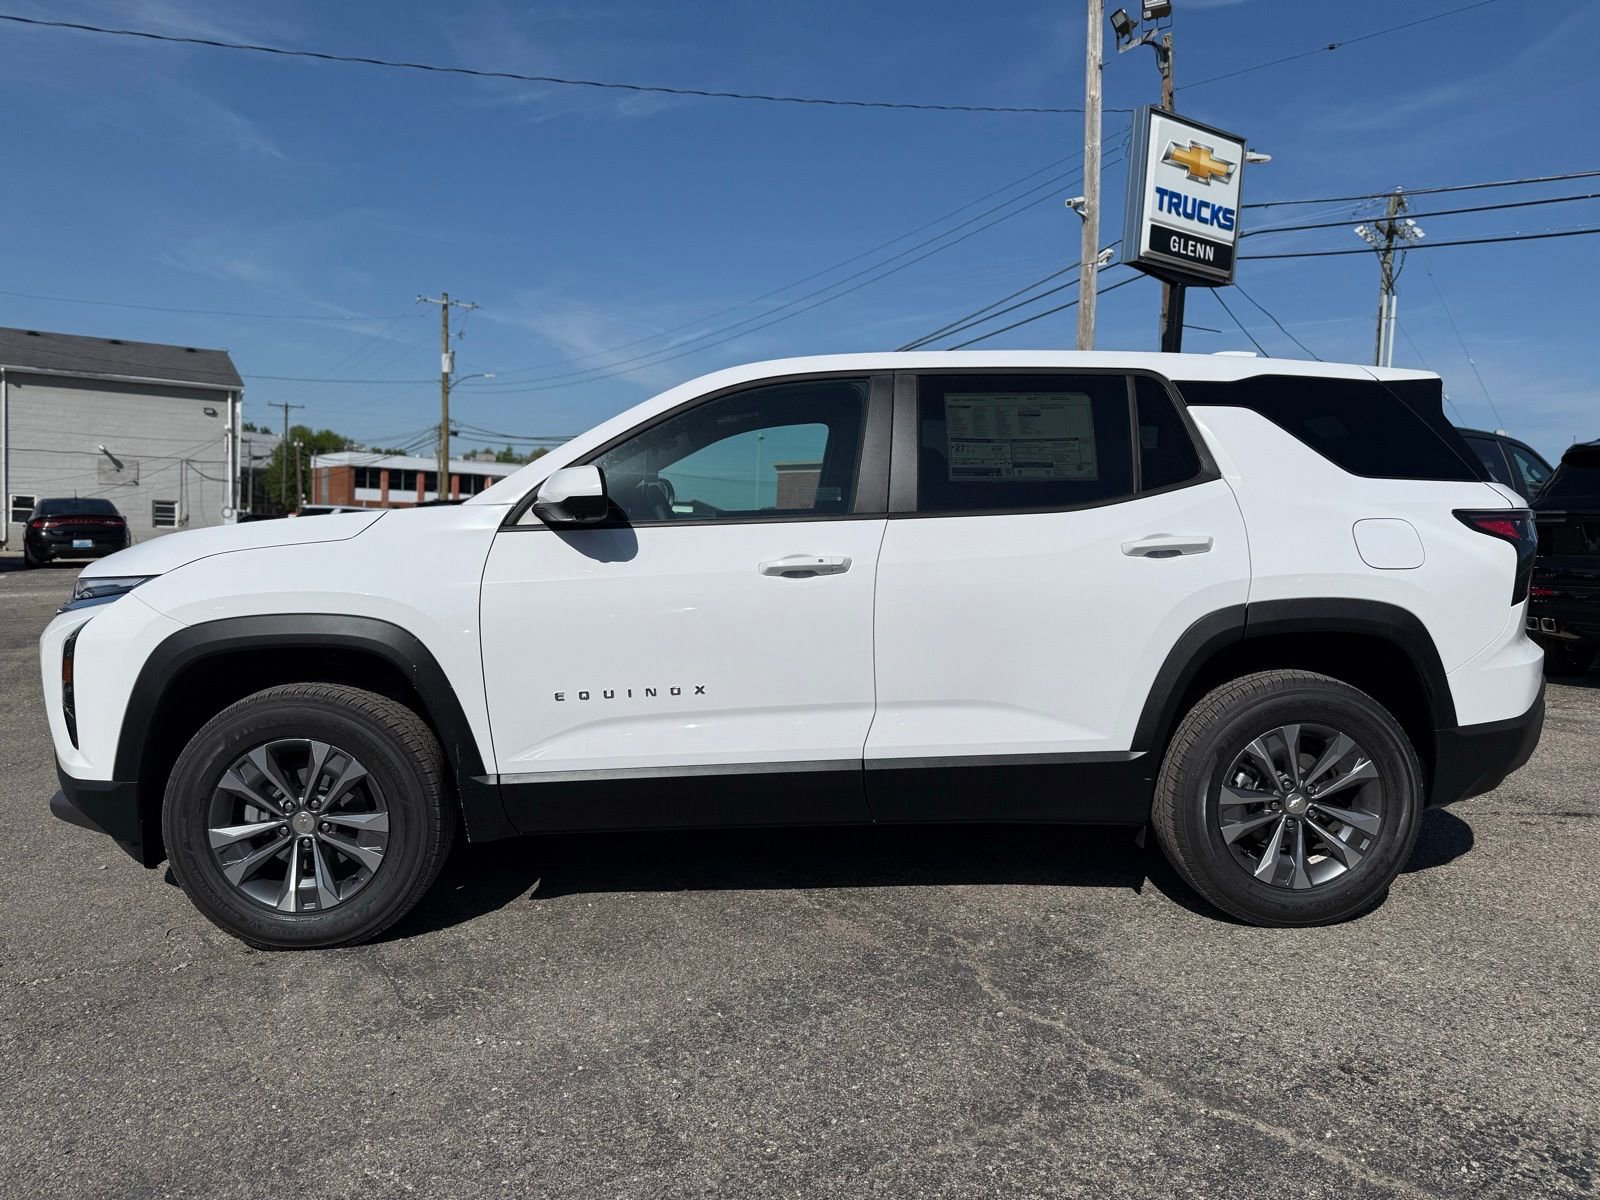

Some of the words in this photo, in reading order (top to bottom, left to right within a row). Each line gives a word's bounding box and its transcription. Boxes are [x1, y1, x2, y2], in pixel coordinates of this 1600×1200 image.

[1155, 186, 1235, 231] TRUCKS
[1170, 236, 1214, 261] GLENN
[554, 685, 705, 701] EQUINOX
